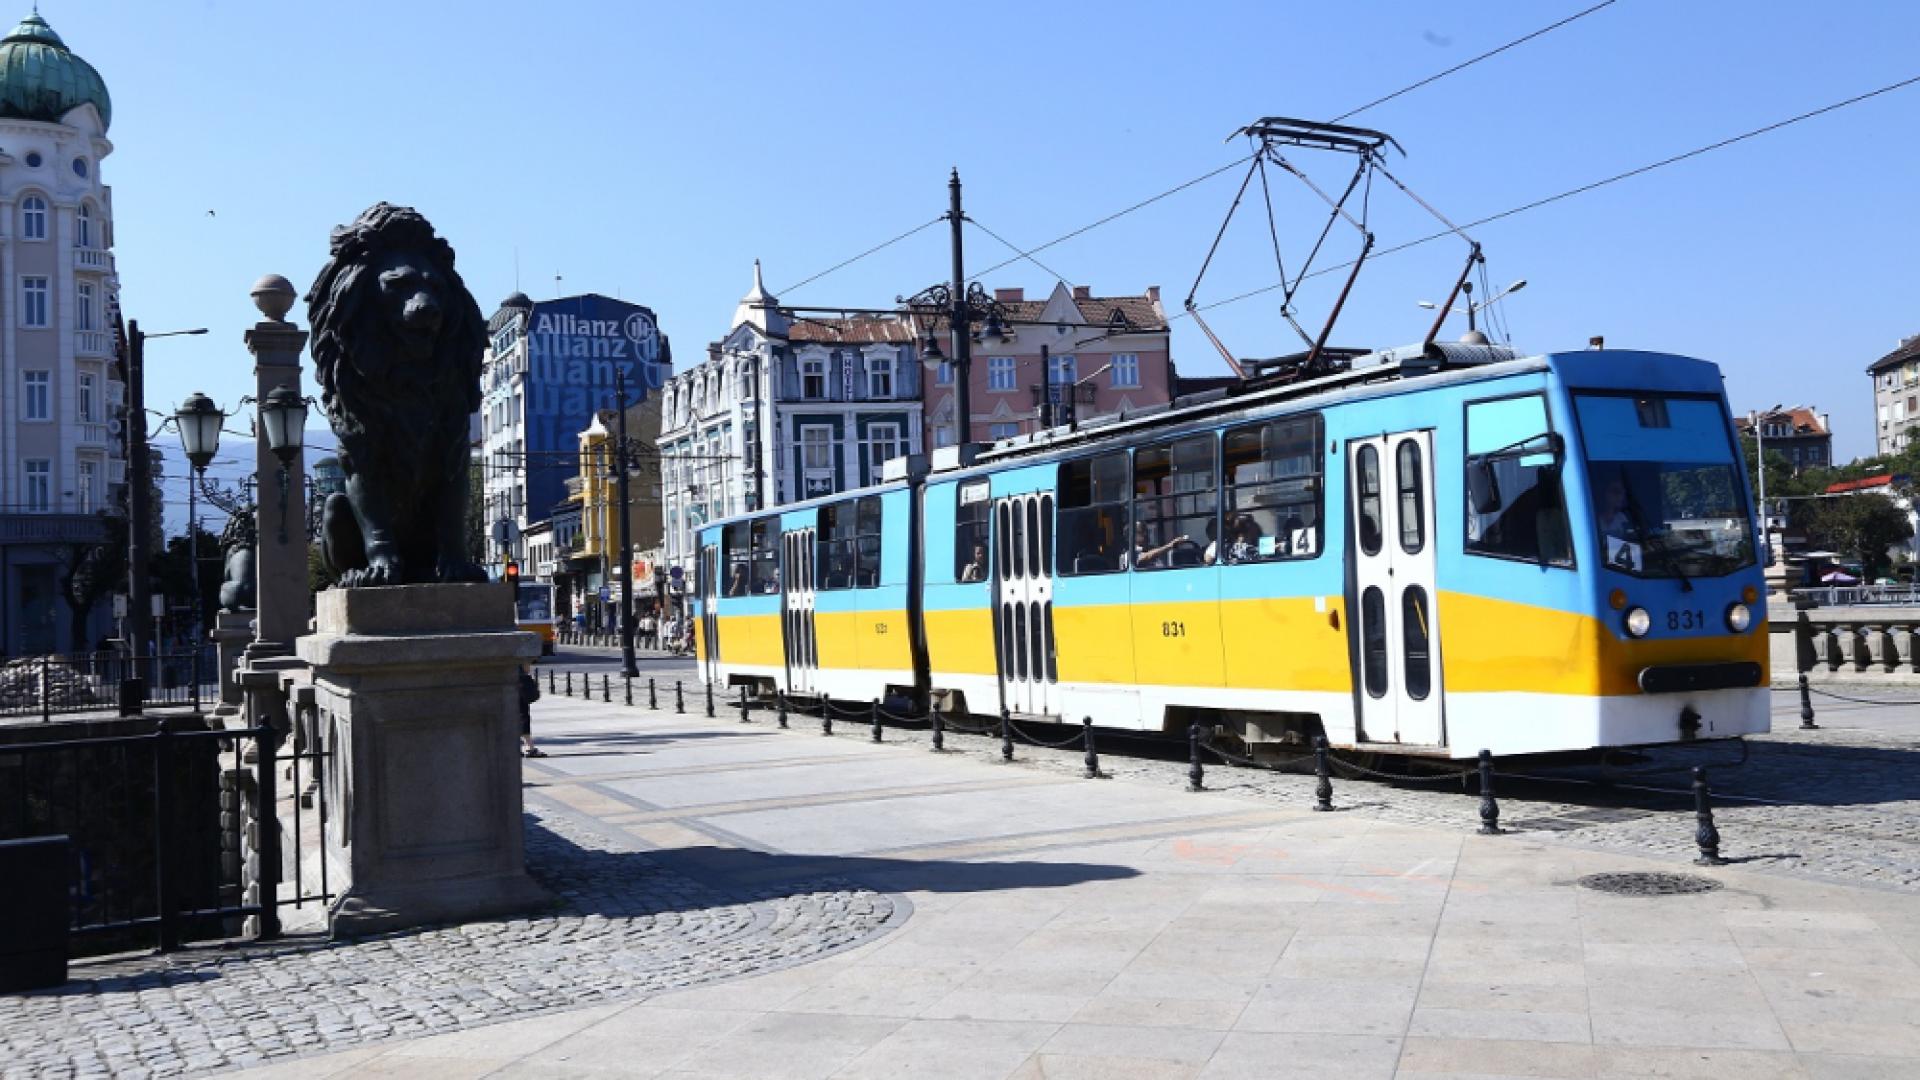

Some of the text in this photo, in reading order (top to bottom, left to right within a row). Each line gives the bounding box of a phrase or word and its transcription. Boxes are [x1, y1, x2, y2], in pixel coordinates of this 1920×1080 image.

[536, 313, 621, 337] Allianz
[1296, 528, 1310, 553] 4
[1614, 541, 1635, 569] 4
[1162, 621, 1186, 638] 831
[1667, 609, 1704, 631] 831
